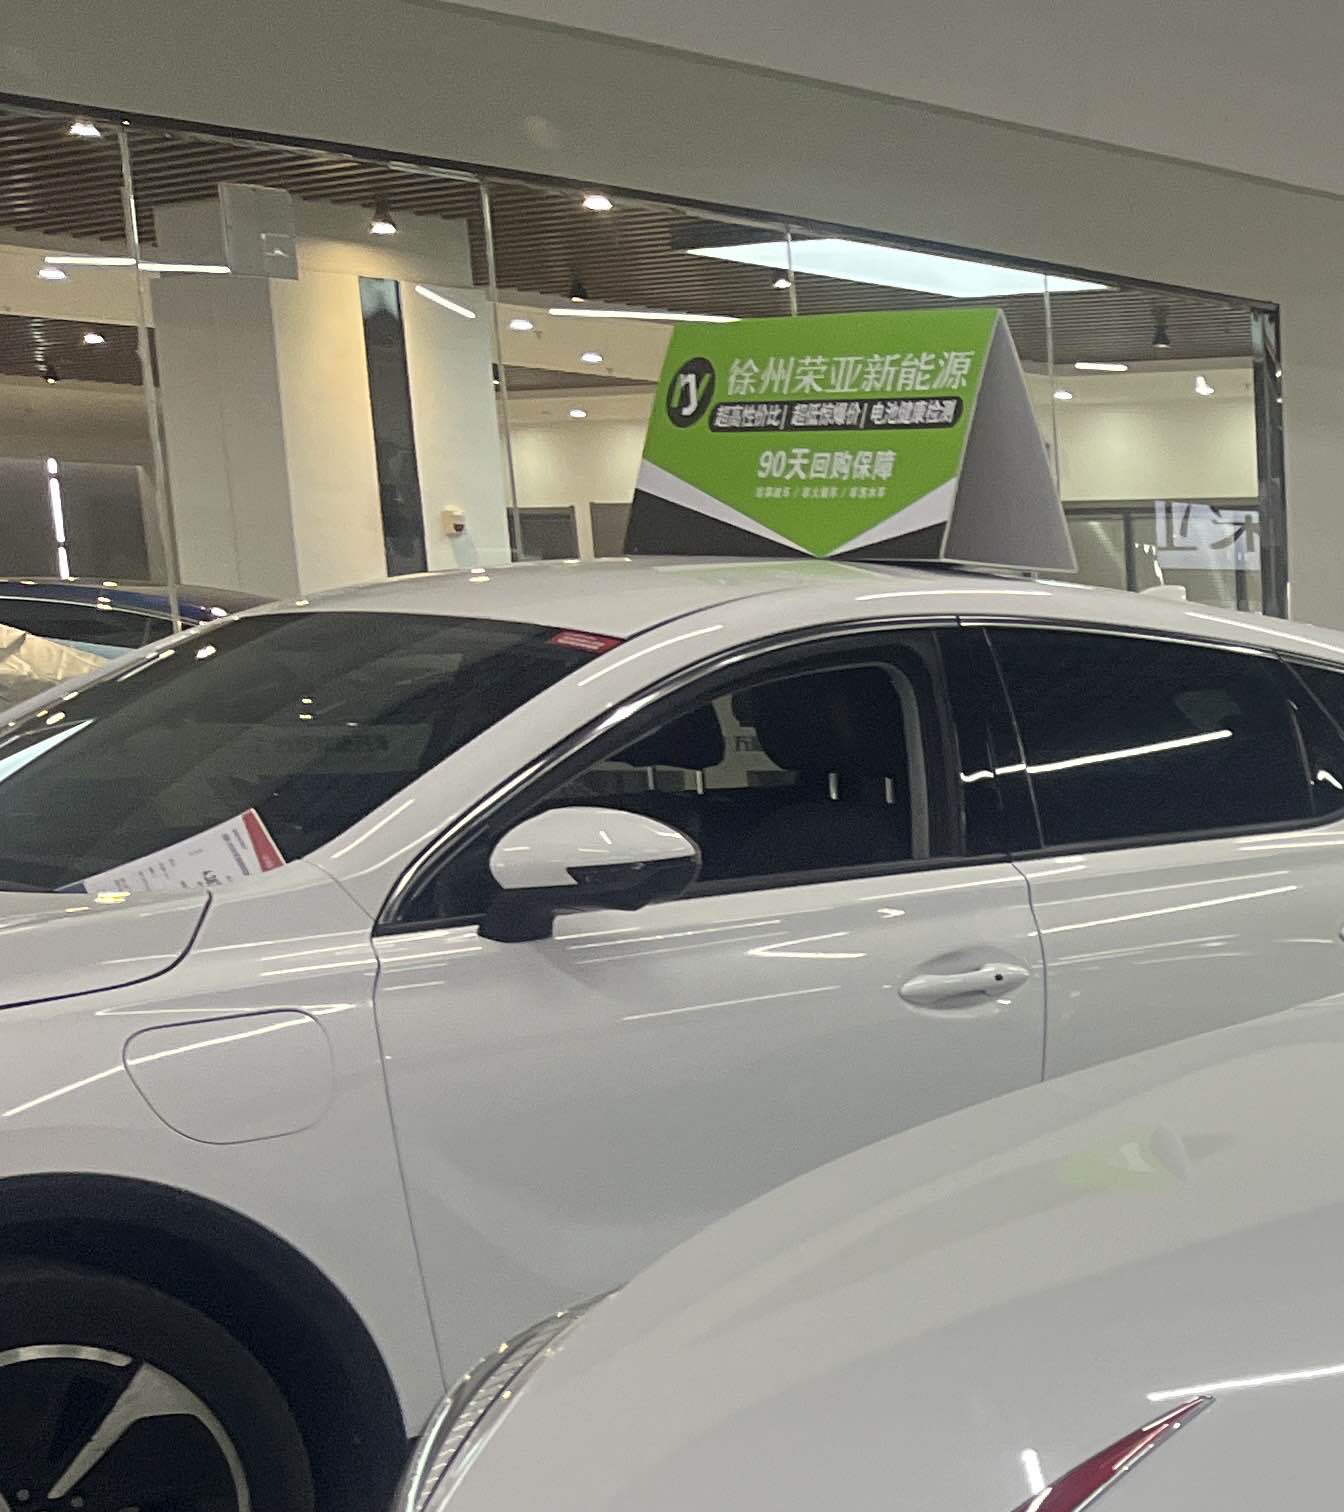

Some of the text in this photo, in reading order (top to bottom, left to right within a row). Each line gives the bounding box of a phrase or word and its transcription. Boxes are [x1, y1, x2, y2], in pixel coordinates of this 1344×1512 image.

[727, 350, 975, 396] 徐州荣亚新能源
[757, 447, 897, 481] 90天回购保障
